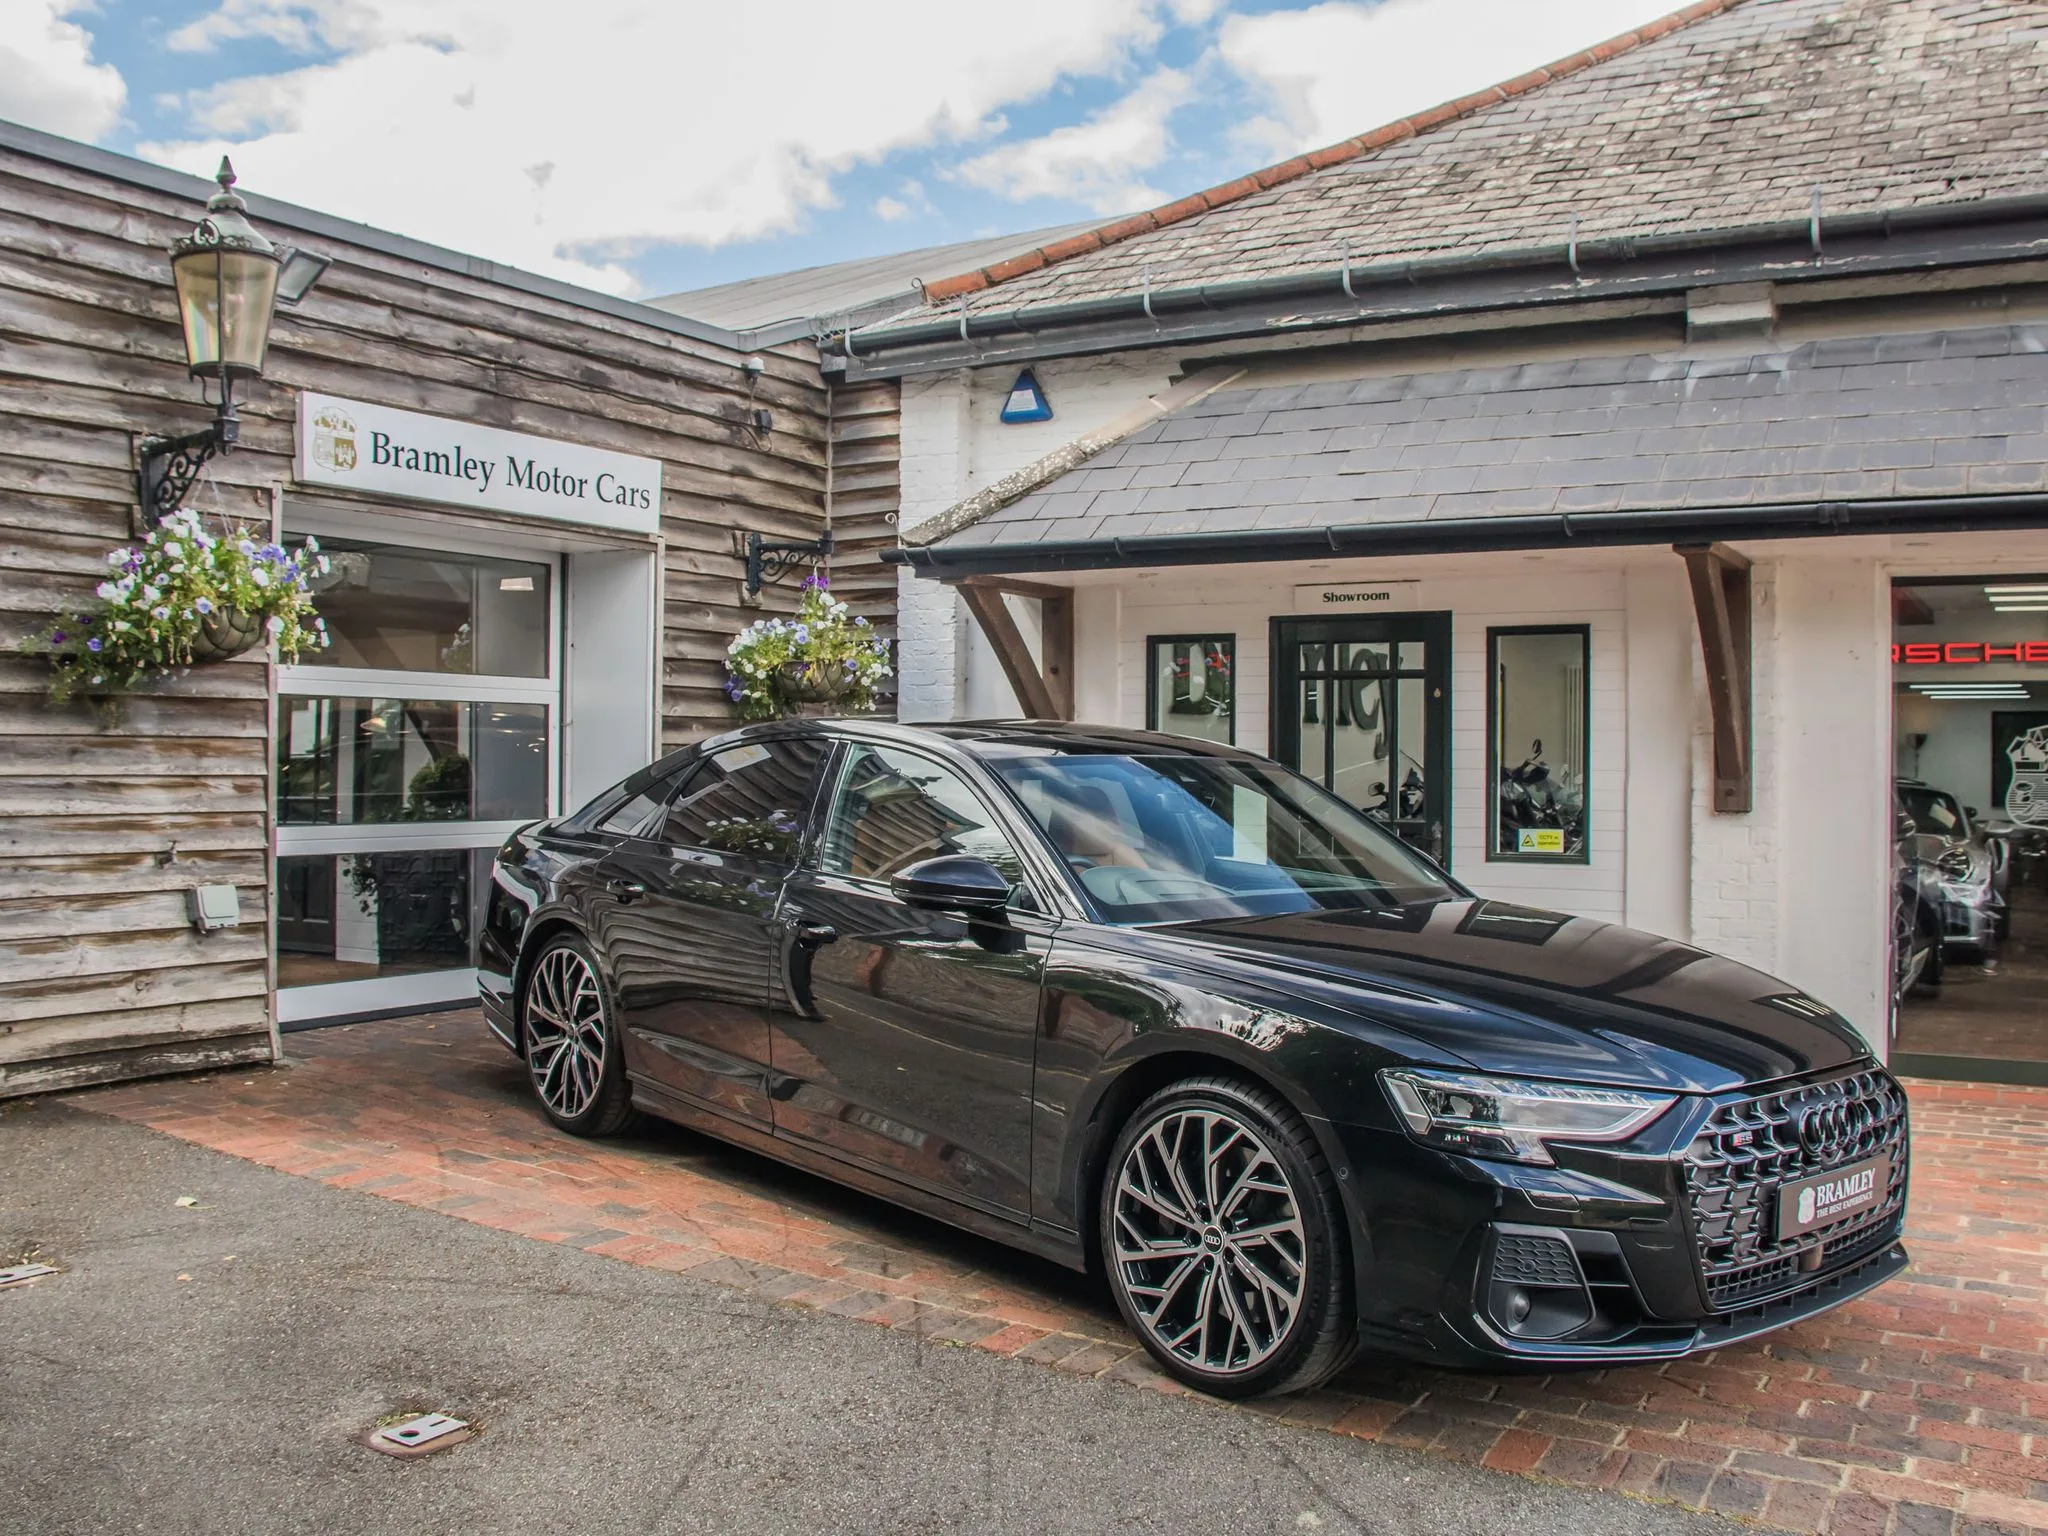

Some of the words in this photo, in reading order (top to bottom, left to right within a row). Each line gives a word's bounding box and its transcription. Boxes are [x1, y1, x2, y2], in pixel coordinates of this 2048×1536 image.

[370, 431, 496, 492] Bramley
[505, 456, 588, 499] Motor
[595, 473, 651, 510] Cars
[1322, 591, 1390, 603] Showroom
[1816, 1167, 1876, 1207] BRAMLEY
